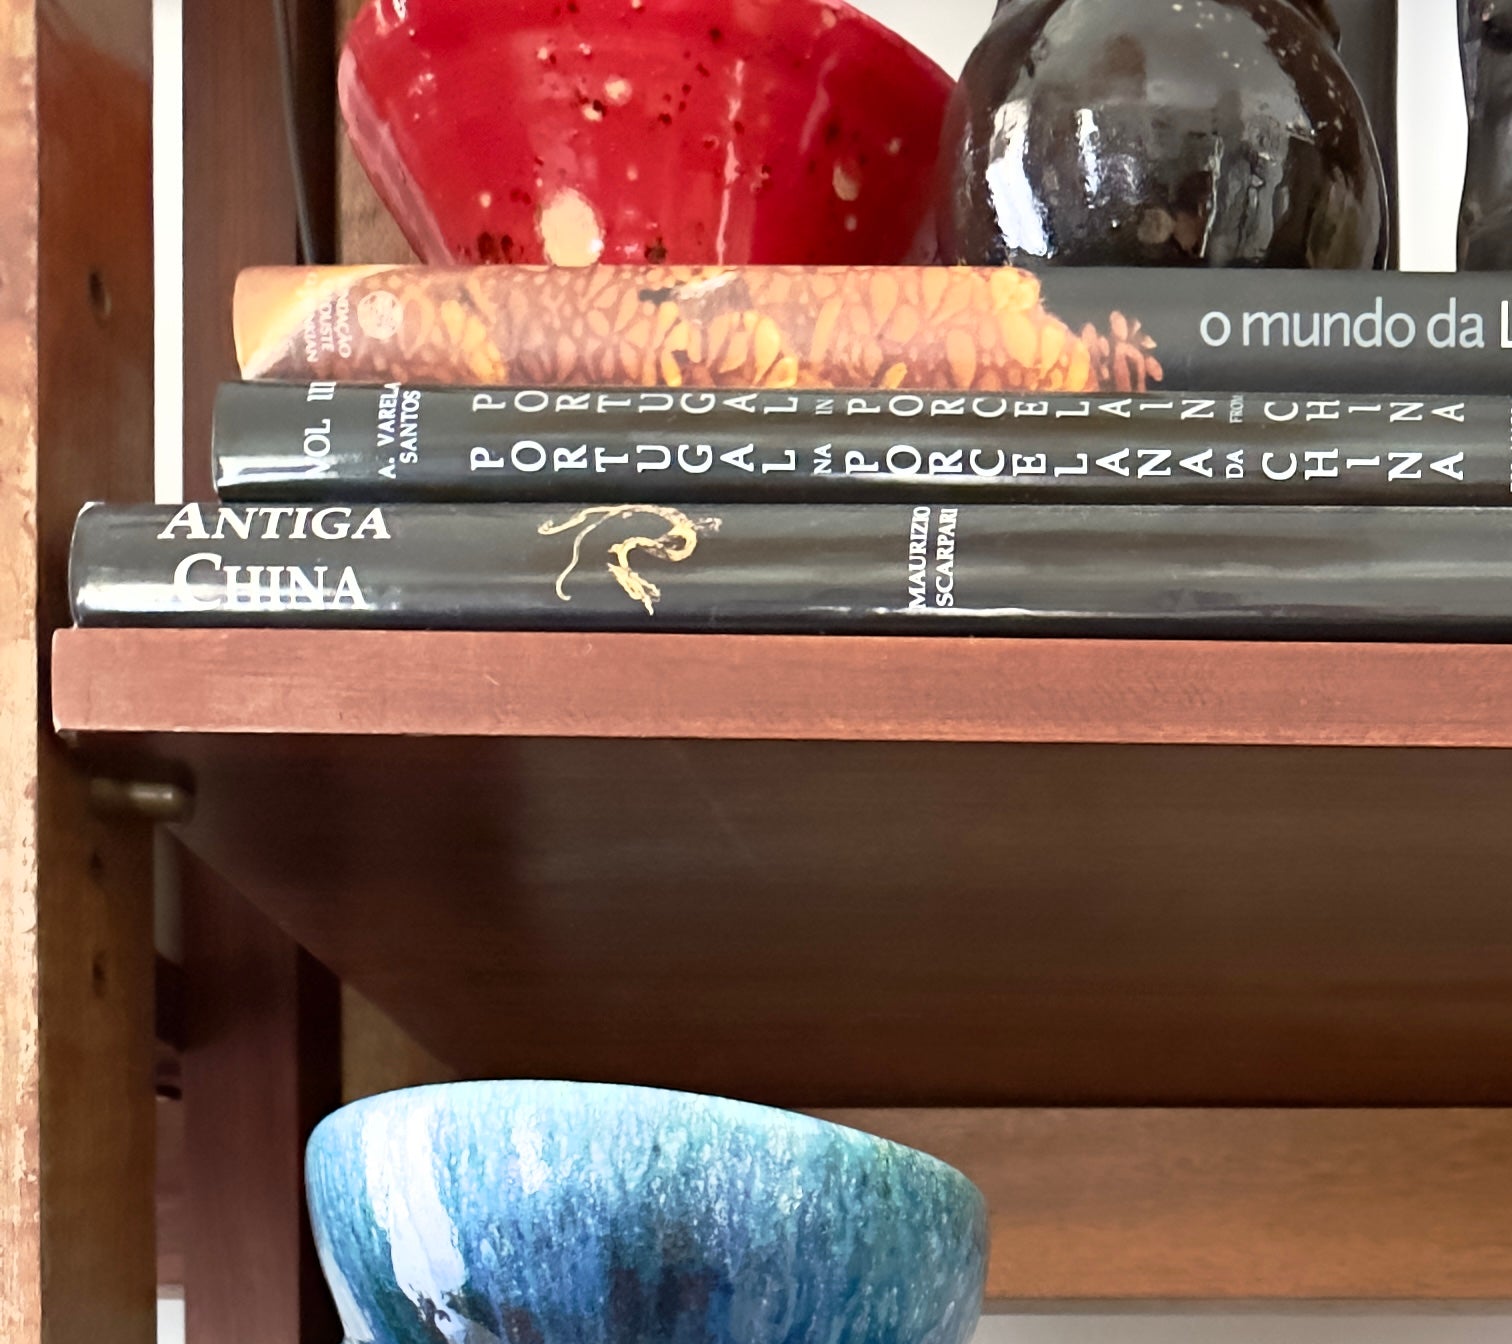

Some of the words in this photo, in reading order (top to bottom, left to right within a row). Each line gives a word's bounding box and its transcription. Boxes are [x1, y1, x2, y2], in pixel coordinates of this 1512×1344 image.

[1199, 310, 1232, 348] o
[1242, 296, 1416, 349] mundo
[1426, 297, 1485, 349] da
[306, 381, 337, 402] III
[377, 382, 401, 447] VARELA
[472, 390, 799, 414] PORTUGAL
[815, 397, 834, 415] IN
[846, 394, 1216, 421] PORCELAIN
[1263, 400, 1466, 423] CHINA
[303, 418, 332, 477] VOL
[399, 390, 421, 464] SANTOS
[377, 457, 397, 480] A.
[470, 440, 797, 474] PORTUGAL
[813, 443, 833, 475] NA
[844, 443, 1214, 480] PORCELANA
[1225, 449, 1244, 479] DA
[1261, 448, 1464, 482] CHINA
[156, 502, 391, 540] ANTIGA
[173, 552, 371, 611] CHINA
[907, 506, 931, 610] MAURIZIO
[935, 507, 958, 608] SCARPARI
